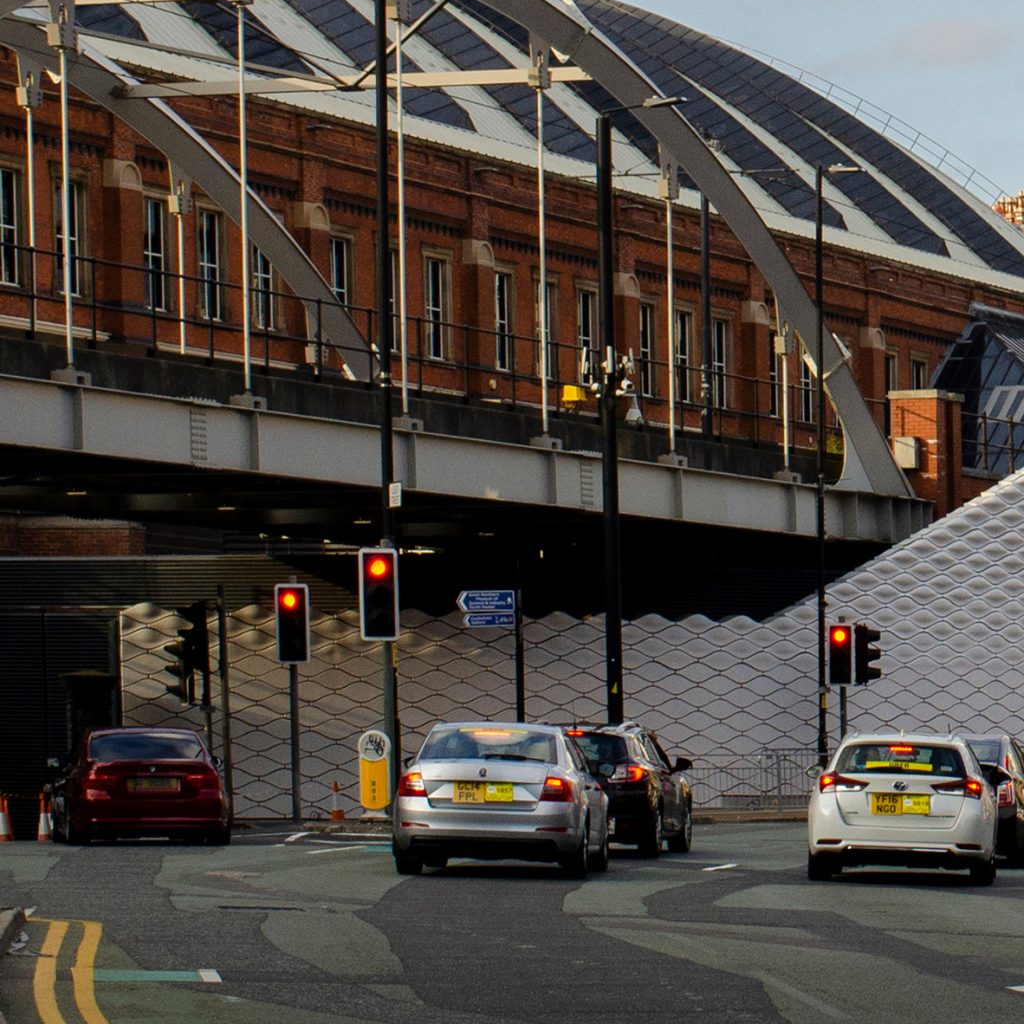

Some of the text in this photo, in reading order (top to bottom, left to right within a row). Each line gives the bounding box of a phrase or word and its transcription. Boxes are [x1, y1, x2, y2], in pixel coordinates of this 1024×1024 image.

[458, 792, 478, 801] FPL
[875, 793, 898, 804] YF16
[877, 805, 896, 813] NGO
